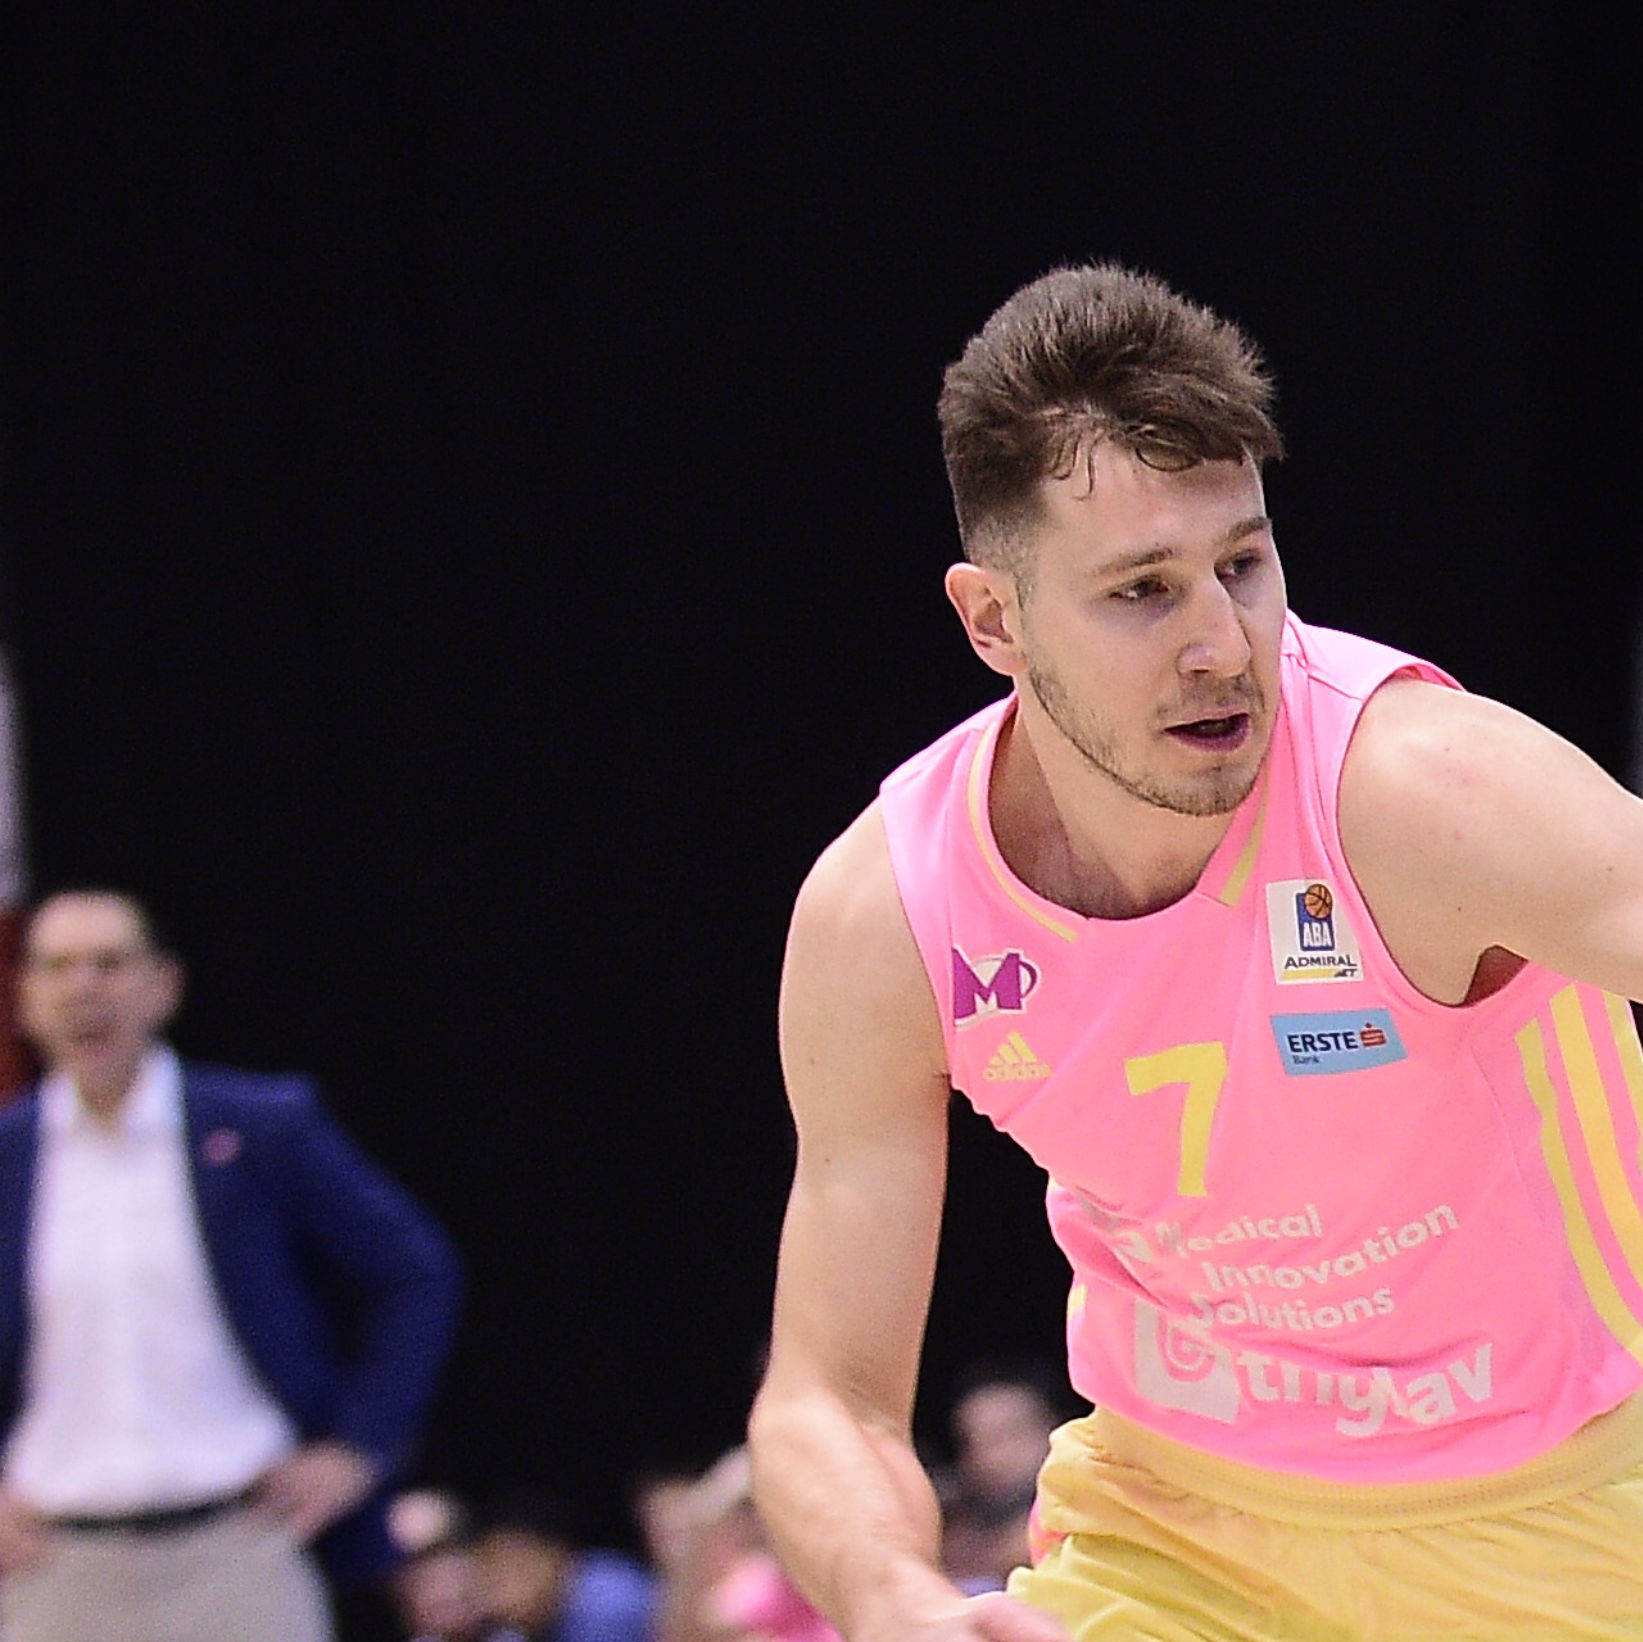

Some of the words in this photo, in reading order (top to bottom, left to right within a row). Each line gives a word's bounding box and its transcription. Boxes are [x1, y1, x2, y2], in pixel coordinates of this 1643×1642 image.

[1303, 921, 1333, 948] ABA
[1284, 954, 1358, 969] ADMIRAL
[1287, 1031, 1359, 1053] ERSTE
[1124, 1041, 1228, 1197] 7
[1201, 1204, 1460, 1292] Innovation
[1190, 1287, 1395, 1333] Solutions
